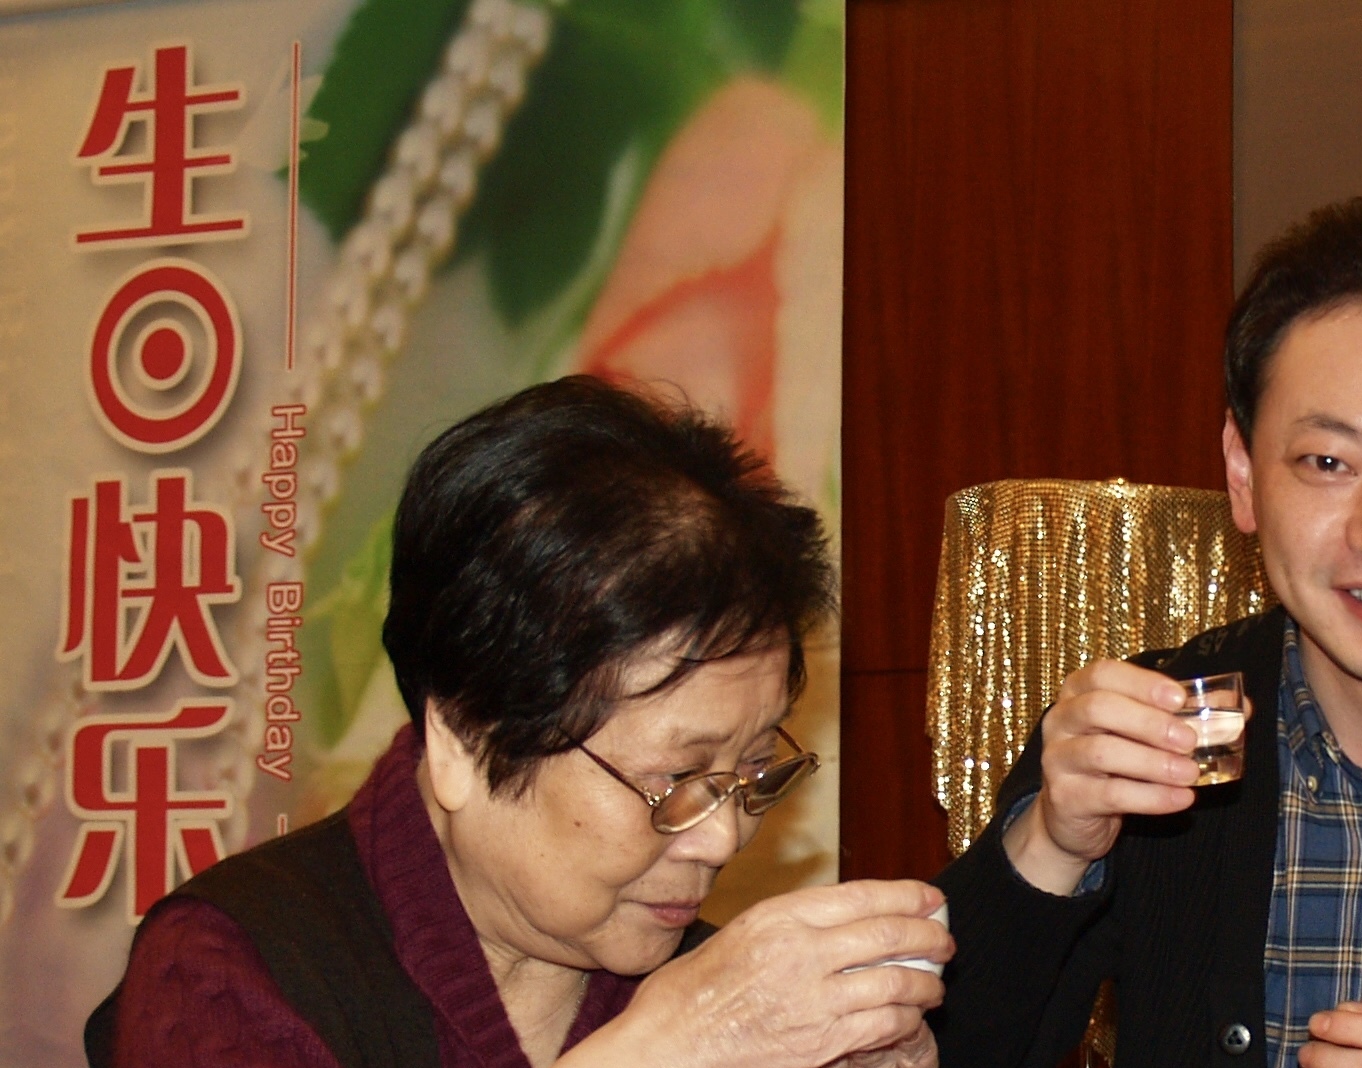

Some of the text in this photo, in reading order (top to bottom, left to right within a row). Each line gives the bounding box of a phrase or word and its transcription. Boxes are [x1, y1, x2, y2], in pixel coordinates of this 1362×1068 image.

[60, 44, 245, 918] 生日快乐
[256, 404, 306, 782] Happy Birthday
